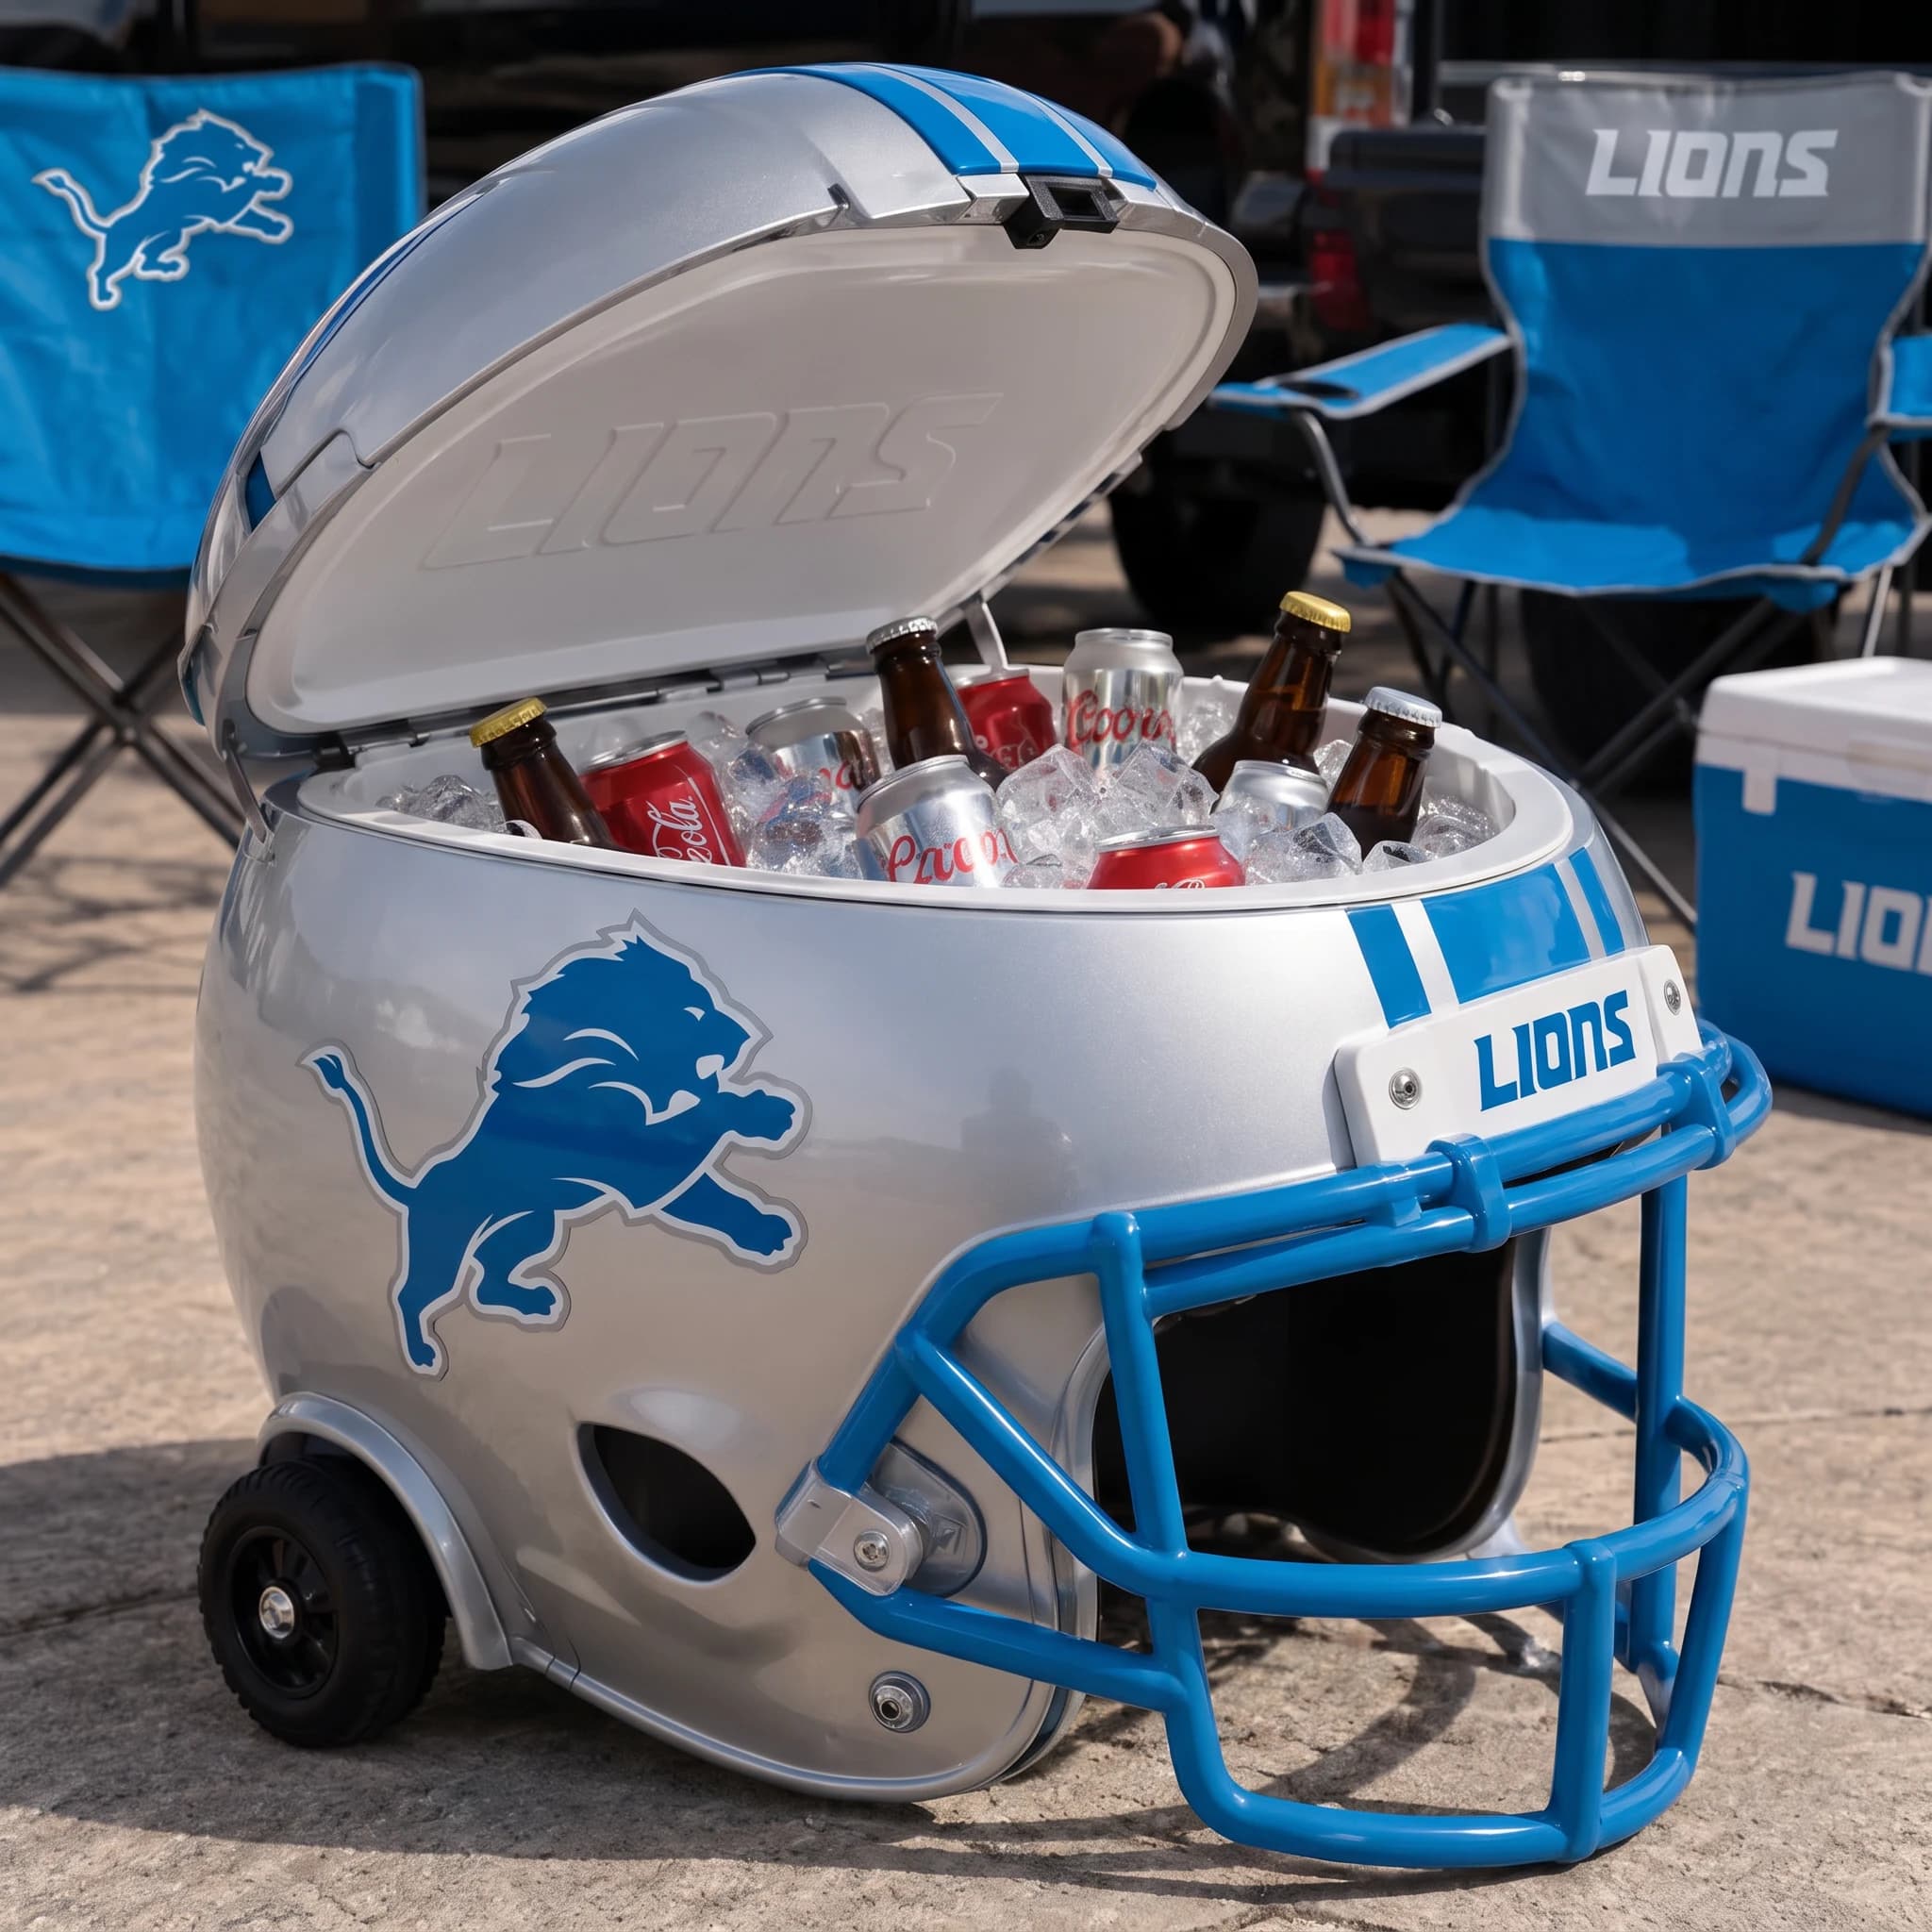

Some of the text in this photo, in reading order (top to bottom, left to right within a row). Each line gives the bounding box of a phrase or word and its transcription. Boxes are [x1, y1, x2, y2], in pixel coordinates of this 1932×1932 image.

[1585, 129, 1839, 197] LIONS
[1786, 870, 1932, 977] LIO
[1473, 989, 1637, 1112] LIONS
